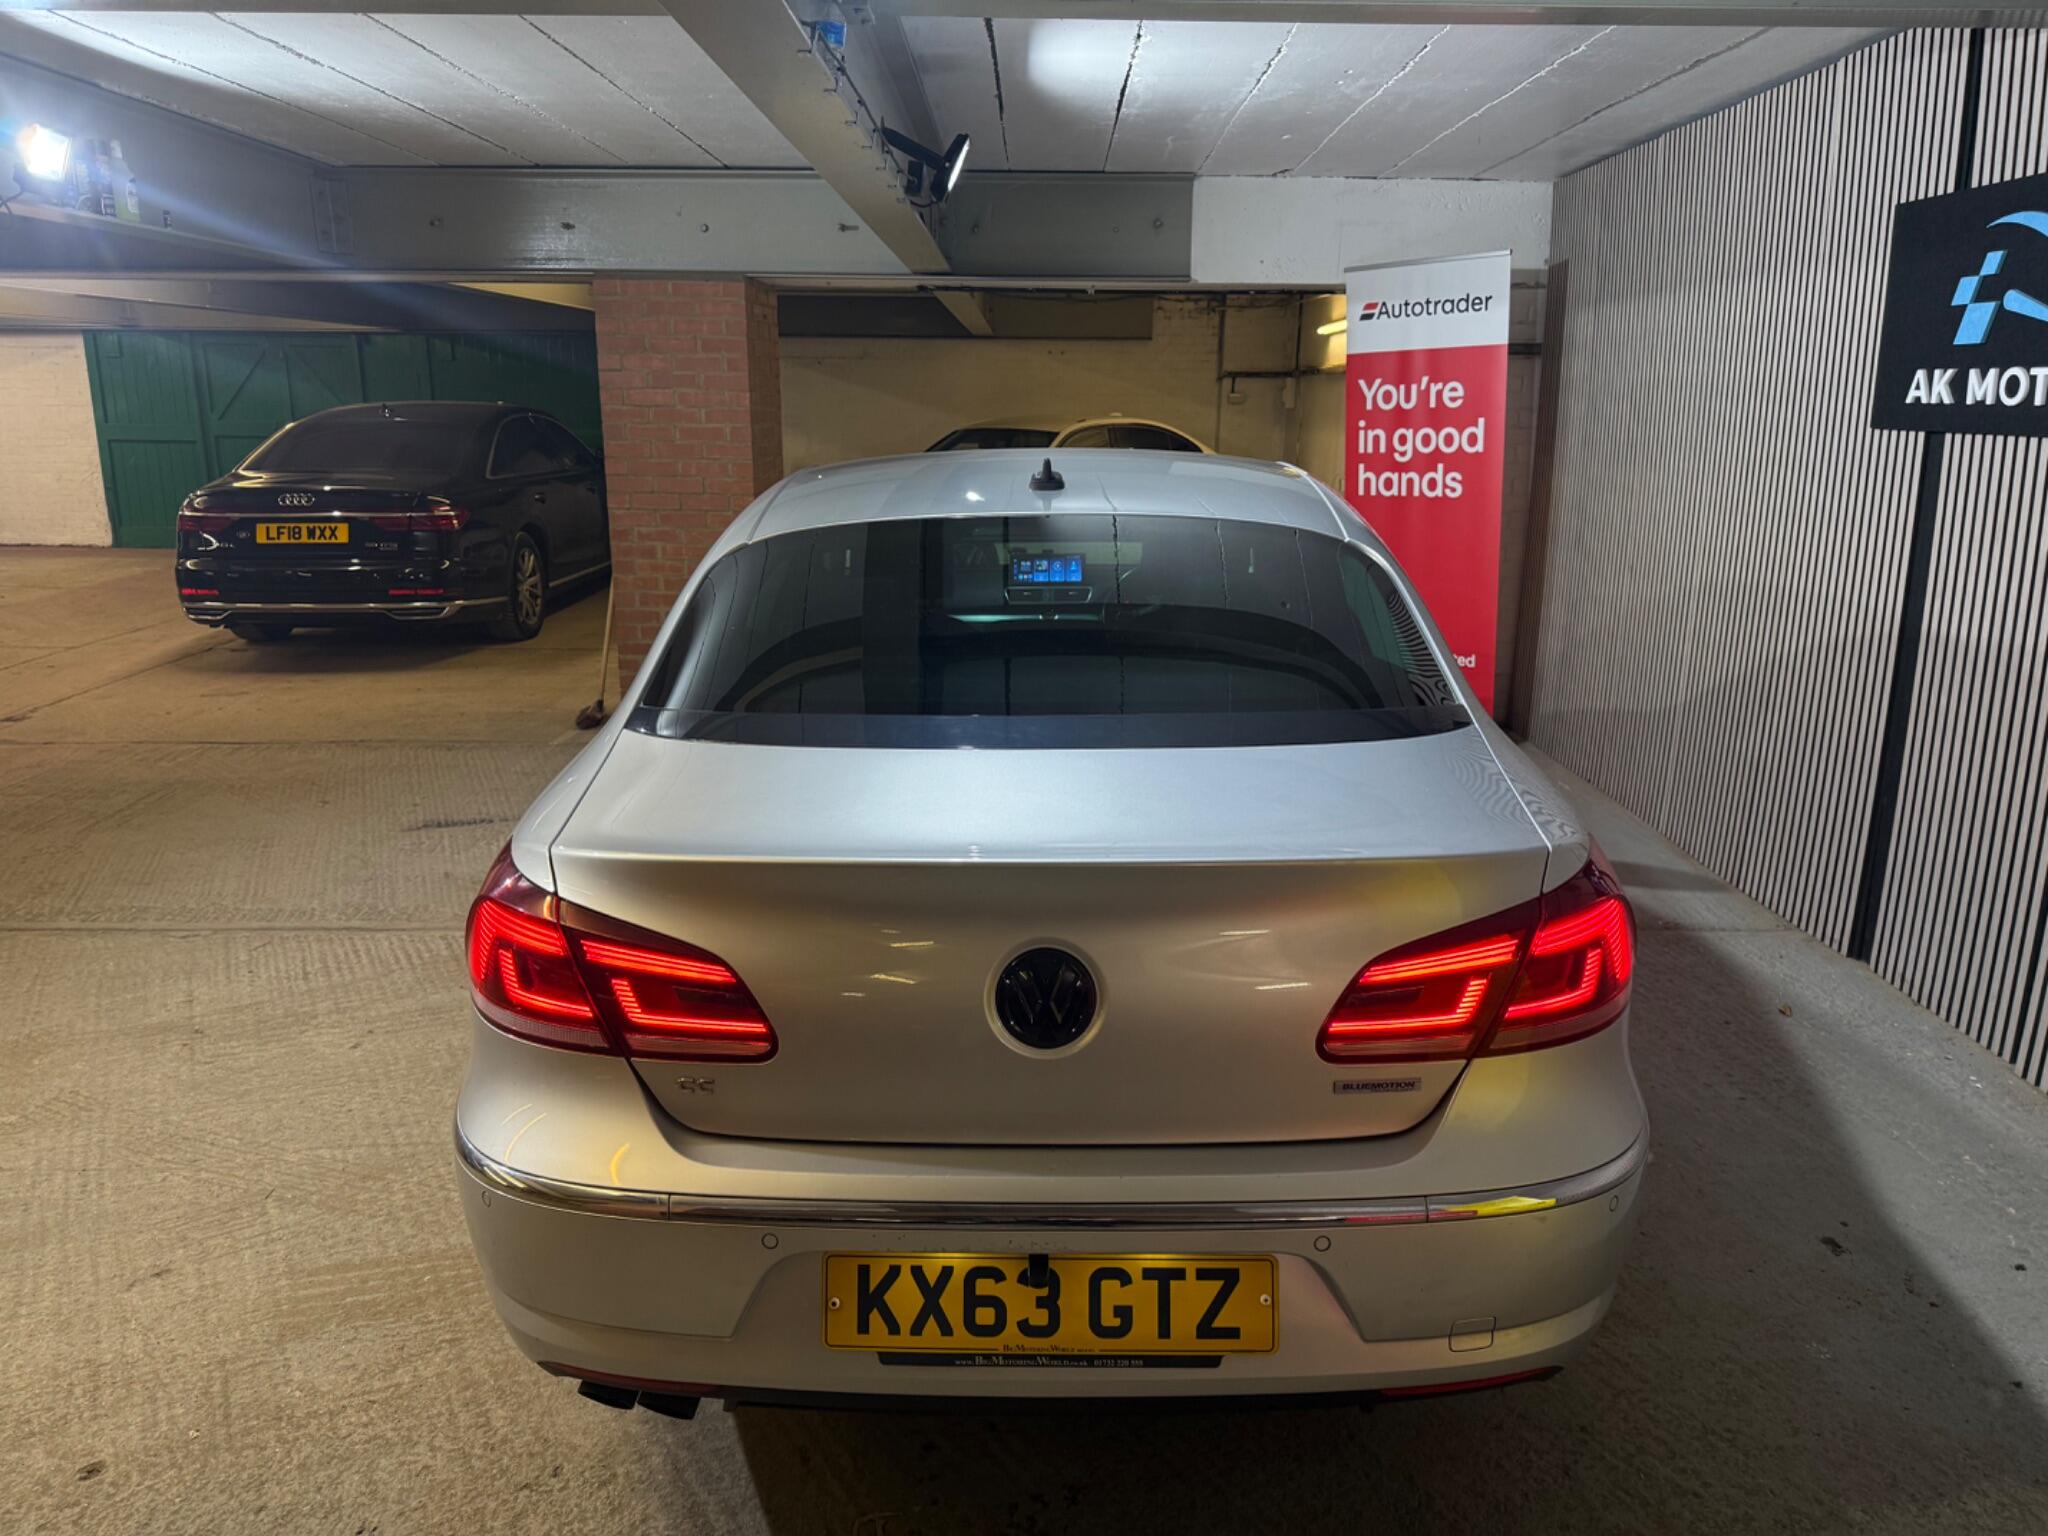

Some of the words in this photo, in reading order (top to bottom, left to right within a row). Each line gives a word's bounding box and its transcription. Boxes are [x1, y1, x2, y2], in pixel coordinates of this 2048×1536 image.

[1376, 292, 1493, 320] Autotrader
[1904, 368, 1959, 405] AK
[1358, 419, 1386, 454] in
[1392, 416, 1485, 463] good
[1358, 463, 1463, 498] hands
[265, 525, 302, 541] LF18
[306, 525, 339, 541] WXX
[1342, 1081, 1416, 1091] BLUEMOTION
[856, 1263, 1062, 1339] KX63
[1087, 1266, 1242, 1340] GTZ
